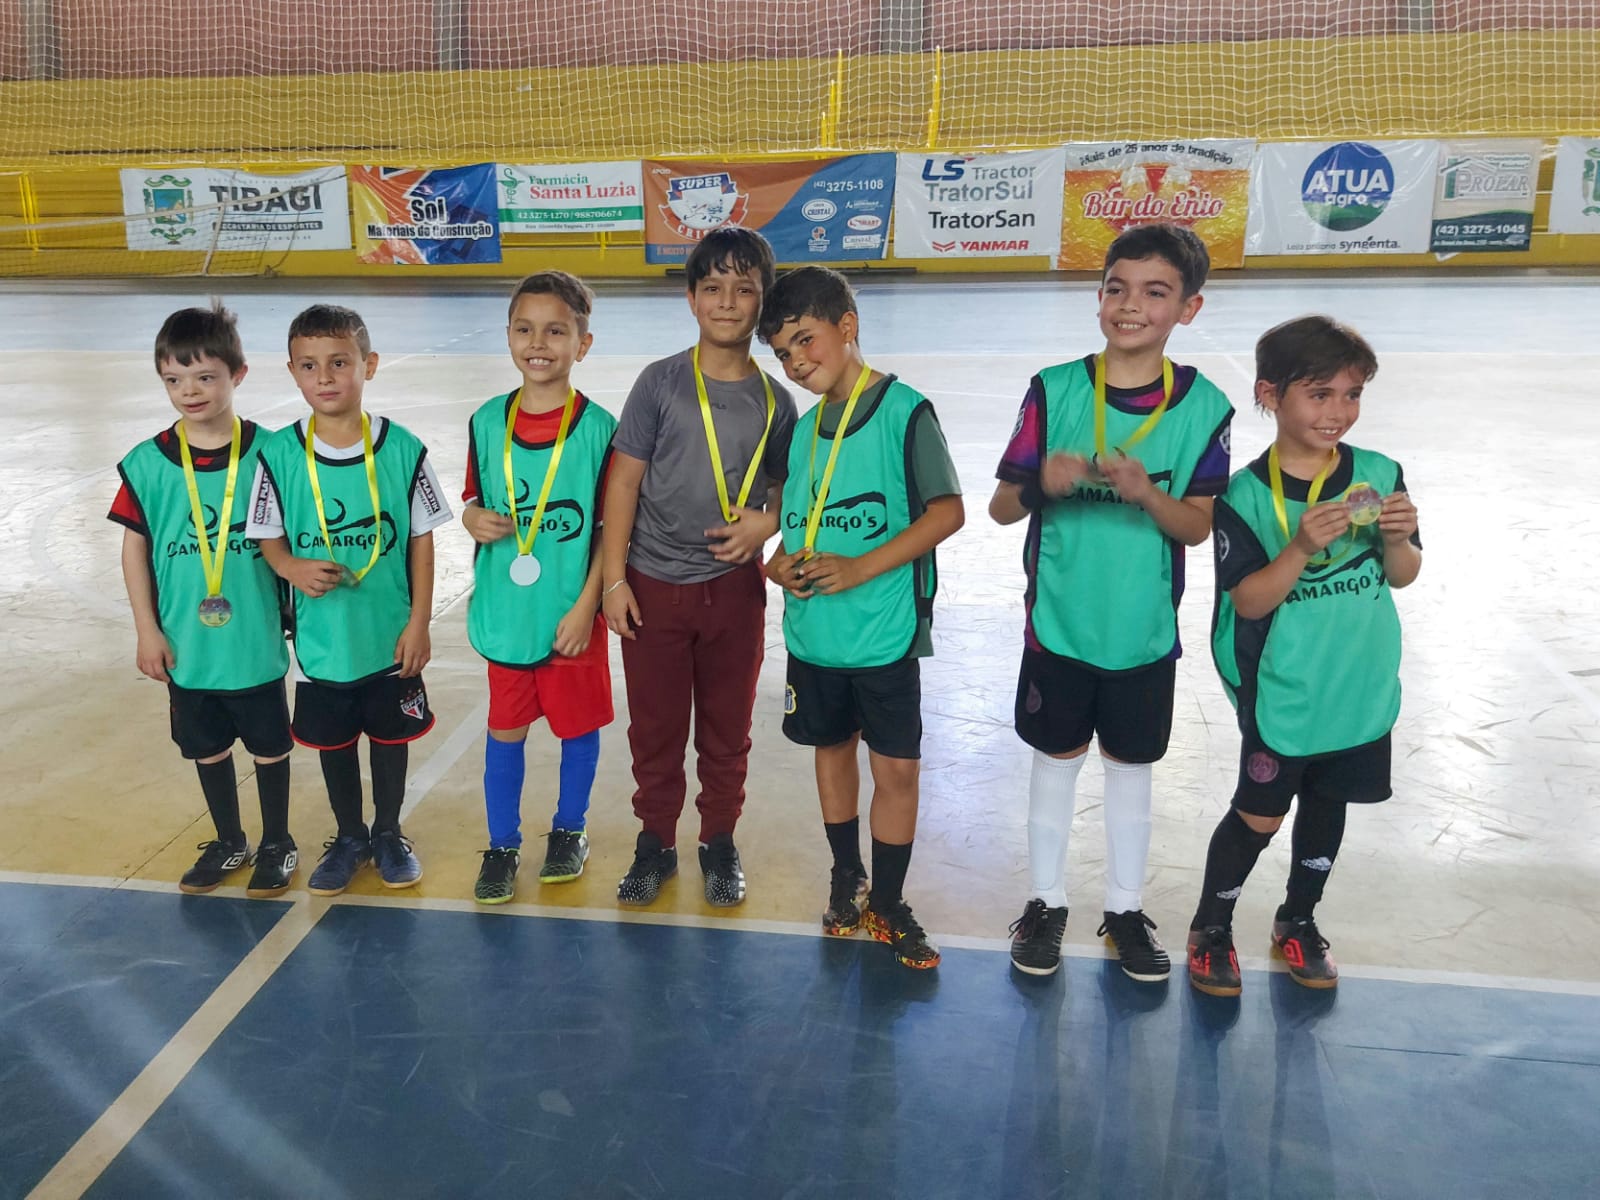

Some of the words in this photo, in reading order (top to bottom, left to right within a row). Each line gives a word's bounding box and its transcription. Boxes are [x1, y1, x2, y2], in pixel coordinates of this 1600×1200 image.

[1080, 152, 1106, 166] Mais
[1108, 145, 1122, 157] de
[1141, 143, 1168, 151] anos
[1171, 143, 1185, 153] de
[1188, 145, 1233, 165] tradição
[529, 173, 588, 185] Farmácia
[922, 159, 966, 181] LS
[971, 165, 1037, 180] Tractor
[530, 185, 581, 200] Santa
[586, 181, 636, 198] Luzia
[679, 177, 722, 190] SUPER
[826, 180, 884, 193] 3275-1108
[925, 180, 1033, 202] TratorSul
[1305, 169, 1389, 194] ATUA
[209, 183, 322, 212] TIBAGI
[1083, 191, 1131, 218] Bar
[1133, 192, 1165, 217] do
[411, 199, 446, 222] Sol
[928, 210, 1035, 229] TratorSan
[217, 223, 265, 231] ECRETARIA
[368, 225, 415, 237] Materiais
[433, 223, 491, 239] Construção
[1435, 224, 1459, 236] (42)
[1462, 224, 1526, 235] 3275-1045
[960, 240, 1030, 252] YANMAR
[1339, 236, 1398, 253] syngenta
